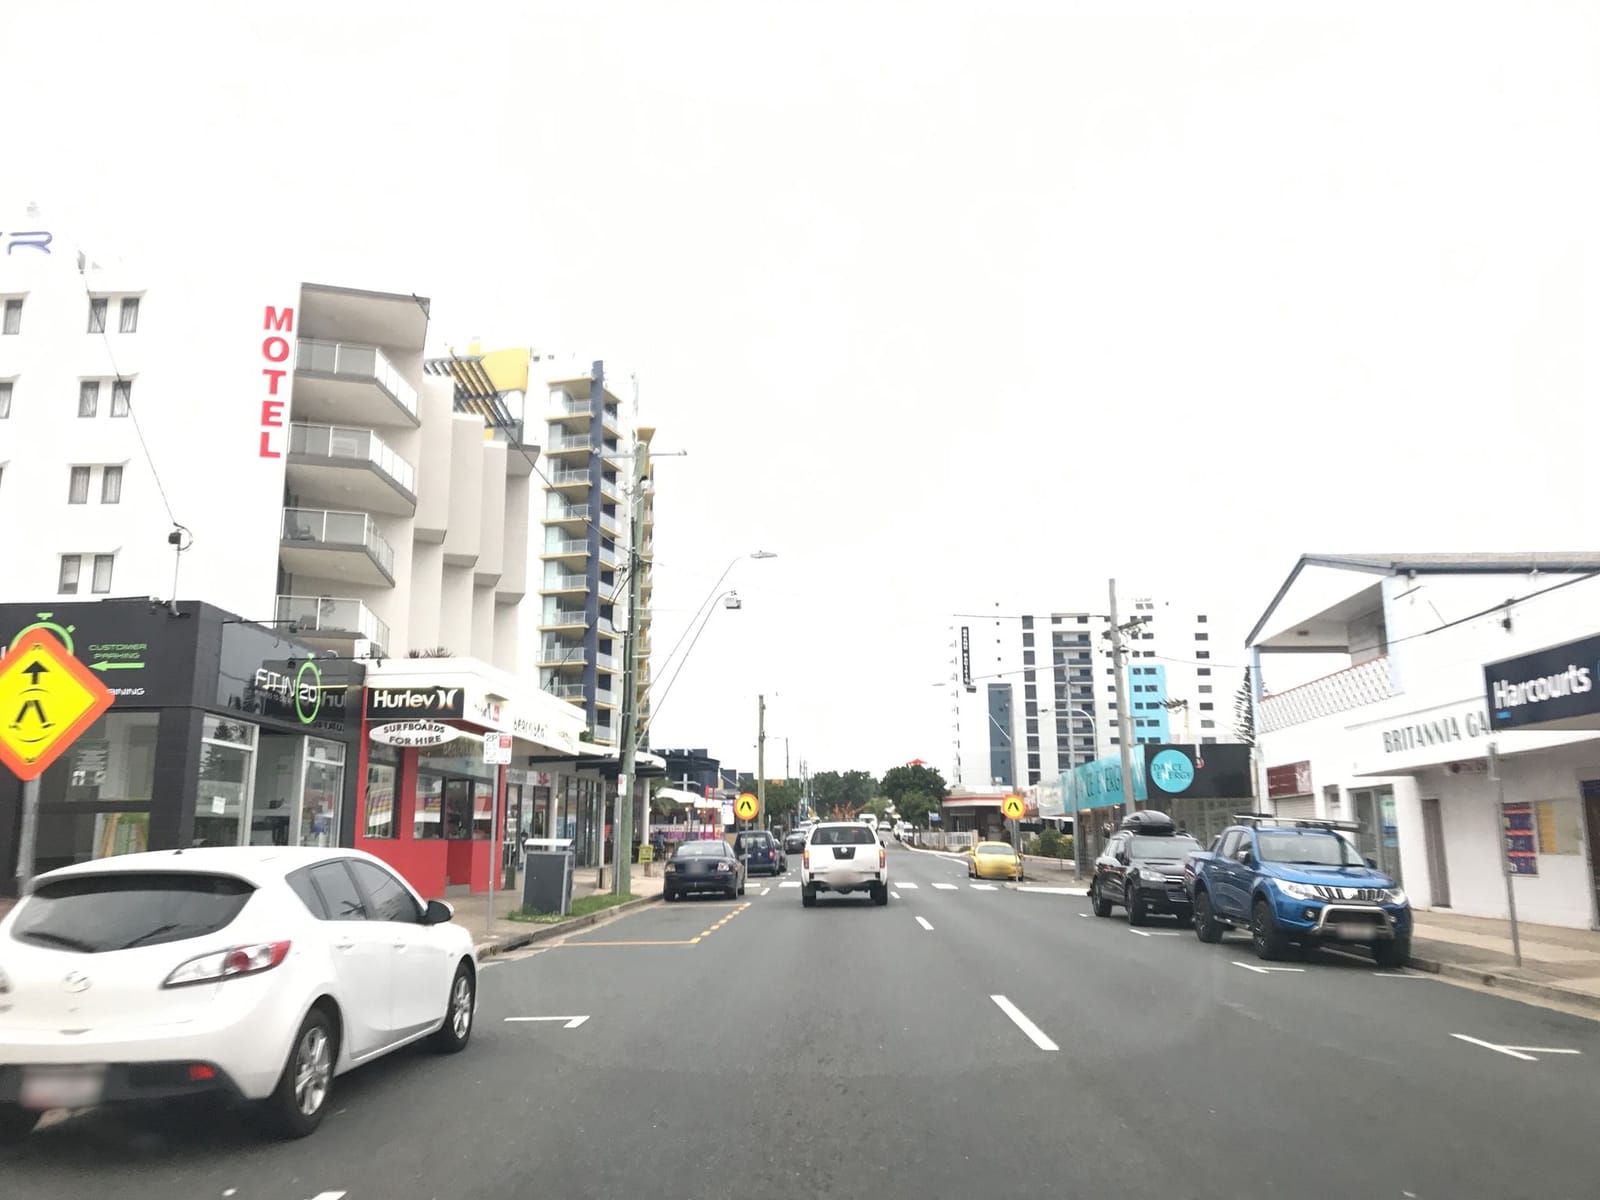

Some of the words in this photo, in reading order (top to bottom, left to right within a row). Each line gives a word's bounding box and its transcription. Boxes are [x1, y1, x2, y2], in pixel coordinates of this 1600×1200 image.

[259, 306, 294, 458] MOTEL
[88, 643, 148, 651] CUSTOMER
[1492, 663, 1592, 709] Harcourts
[373, 689, 436, 710] Hurley
[383, 723, 446, 734] SURFBOARDS
[389, 736, 412, 745] FOR
[415, 735, 442, 745] HIRE
[486, 734, 498, 742] 2P
[1382, 717, 1462, 753] BRITANNIA
[1153, 761, 1183, 773] DANCE
